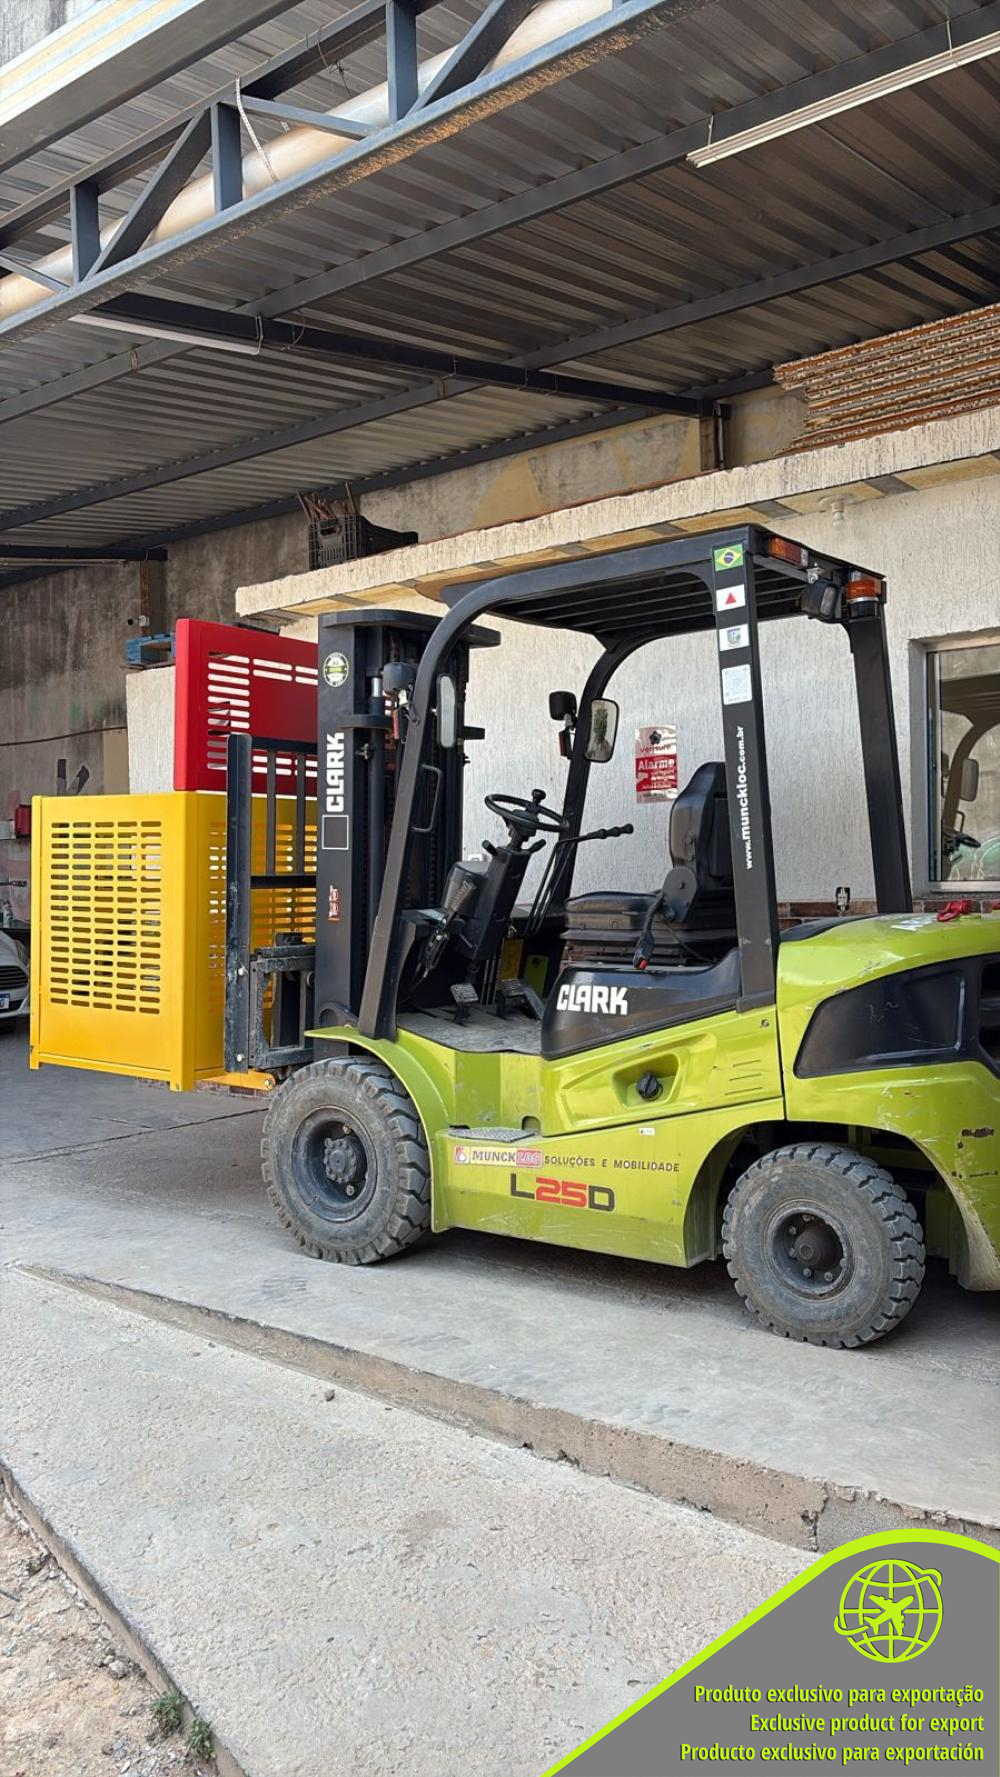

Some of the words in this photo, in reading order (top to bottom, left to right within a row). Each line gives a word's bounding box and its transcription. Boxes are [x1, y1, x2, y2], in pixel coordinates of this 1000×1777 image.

[326, 732, 345, 812] CLARK
[638, 758, 675, 771] Alarme
[736, 725, 753, 870] www.munckloc.com.br
[556, 984, 628, 1016] CLARK
[544, 1155, 595, 1168] SOLUÇÕES
[601, 1159, 608, 1168] E
[613, 1159, 680, 1172] MOBILIDADE
[510, 1173, 615, 1212] L25D
